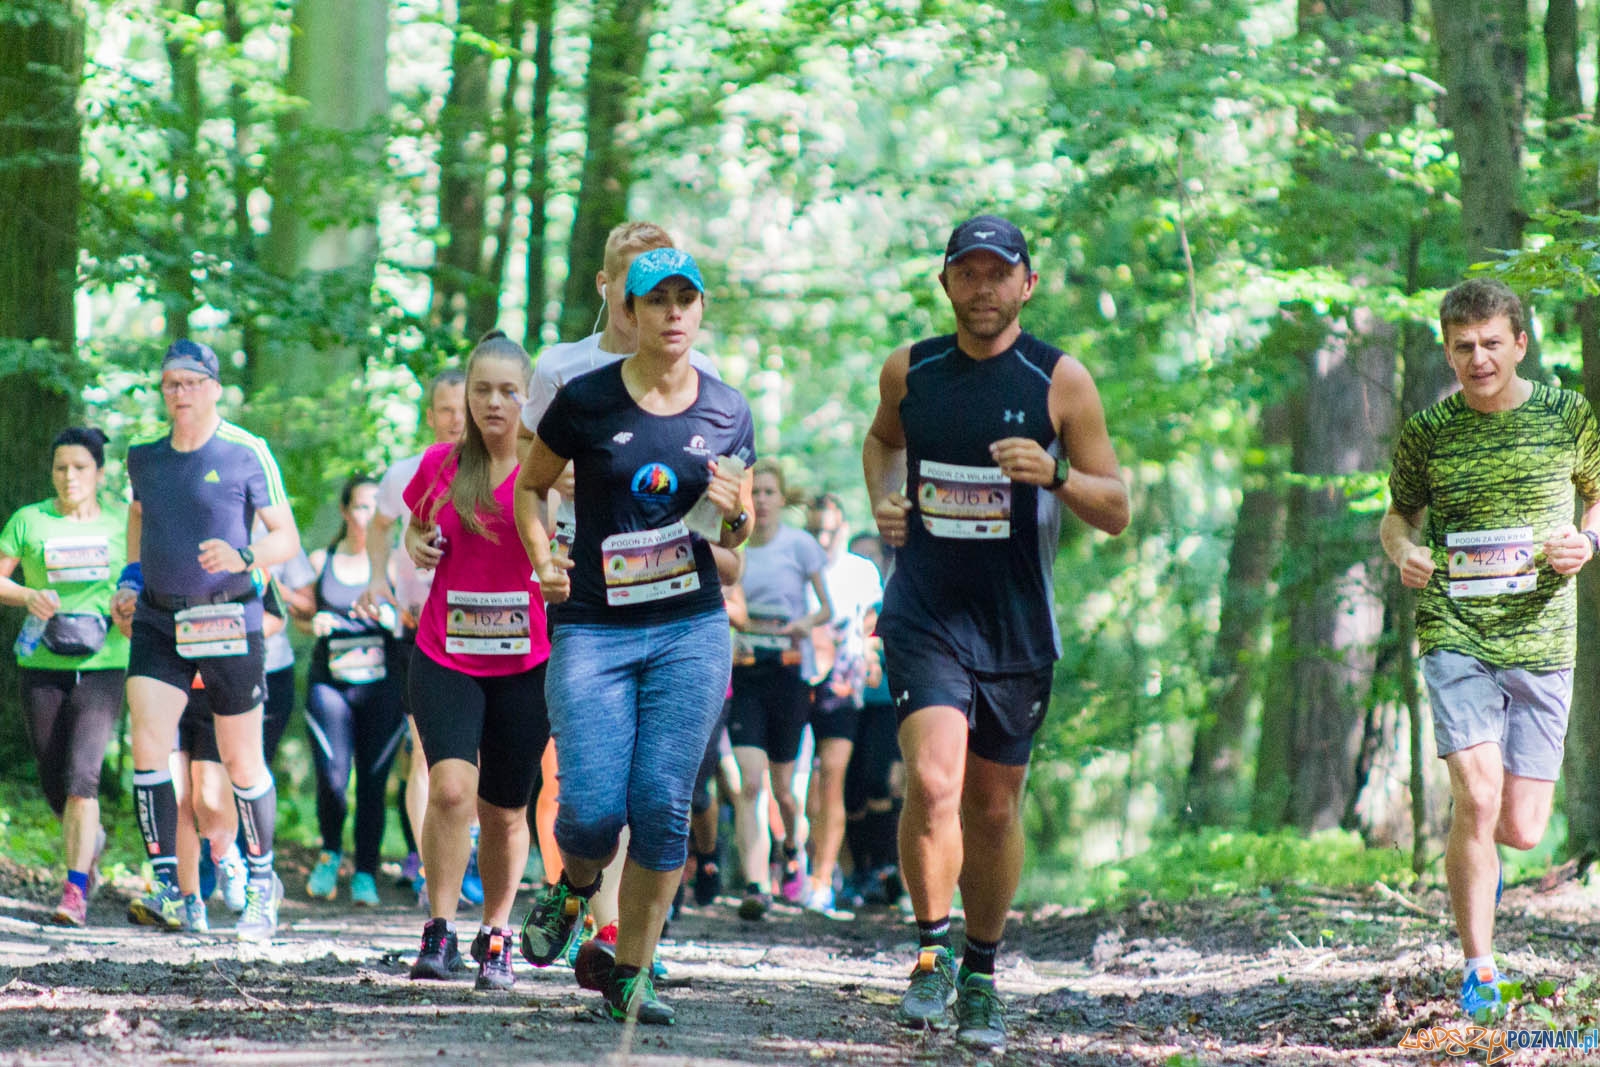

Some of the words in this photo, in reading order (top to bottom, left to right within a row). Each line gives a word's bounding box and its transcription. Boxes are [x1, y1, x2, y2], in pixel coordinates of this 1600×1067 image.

[941, 487, 980, 505] 206
[642, 536, 654, 545] ZA
[1482, 535, 1492, 543] ZA
[641, 549, 662, 569] 17
[1473, 548, 1506, 566] 424
[472, 611, 504, 626] 162
